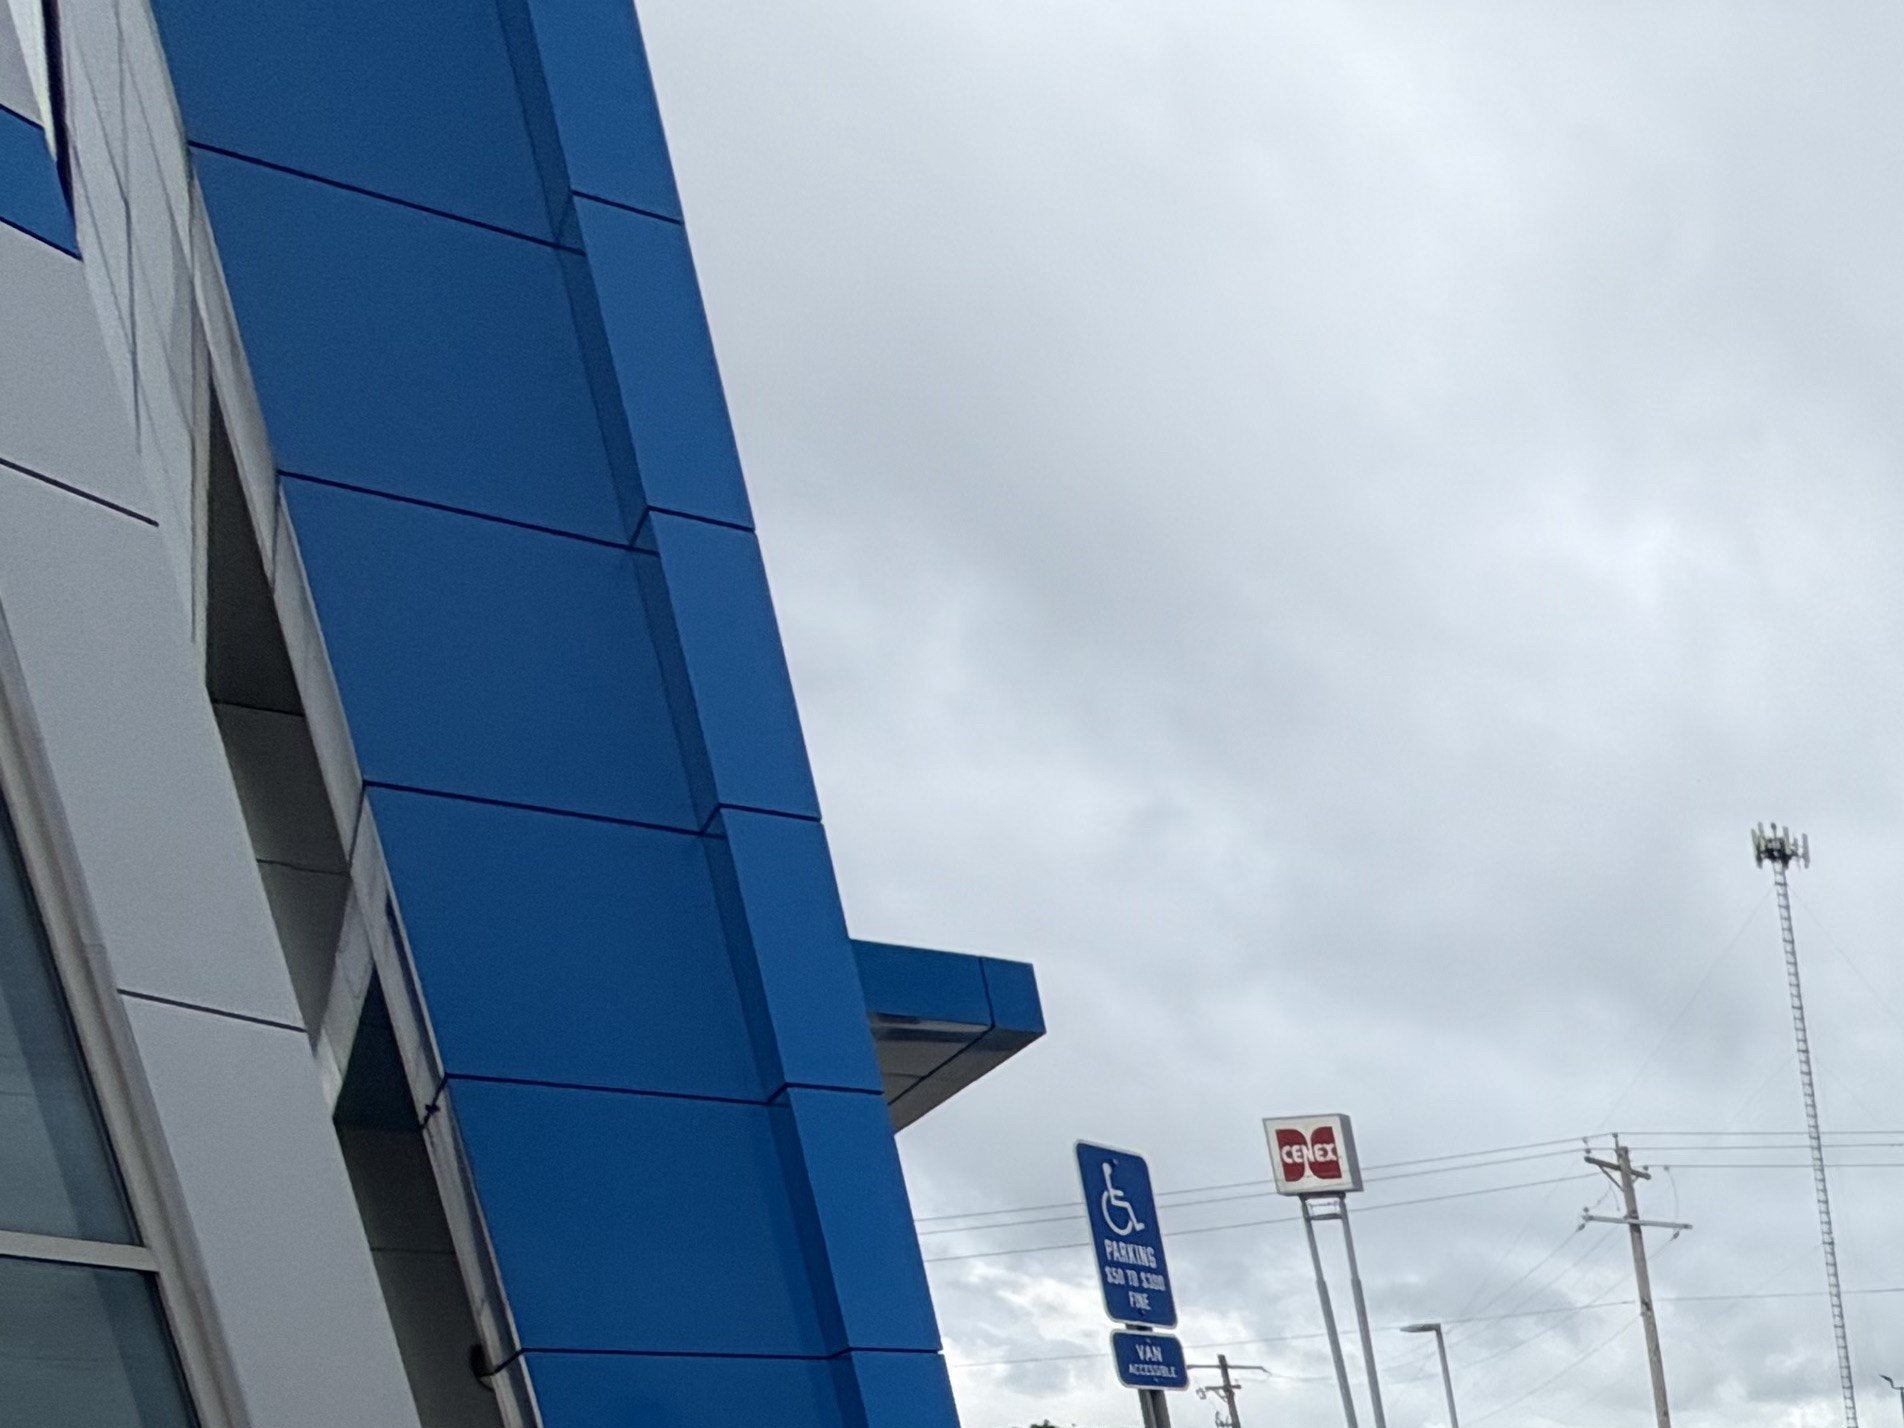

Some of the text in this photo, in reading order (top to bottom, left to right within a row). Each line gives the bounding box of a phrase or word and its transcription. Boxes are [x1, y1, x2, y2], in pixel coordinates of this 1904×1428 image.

[1281, 1143, 1338, 1164] CENEX
[1104, 1238, 1158, 1269] PARKING
[1128, 1291, 1152, 1310] FINE
[1135, 1344, 1163, 1362] VAN
